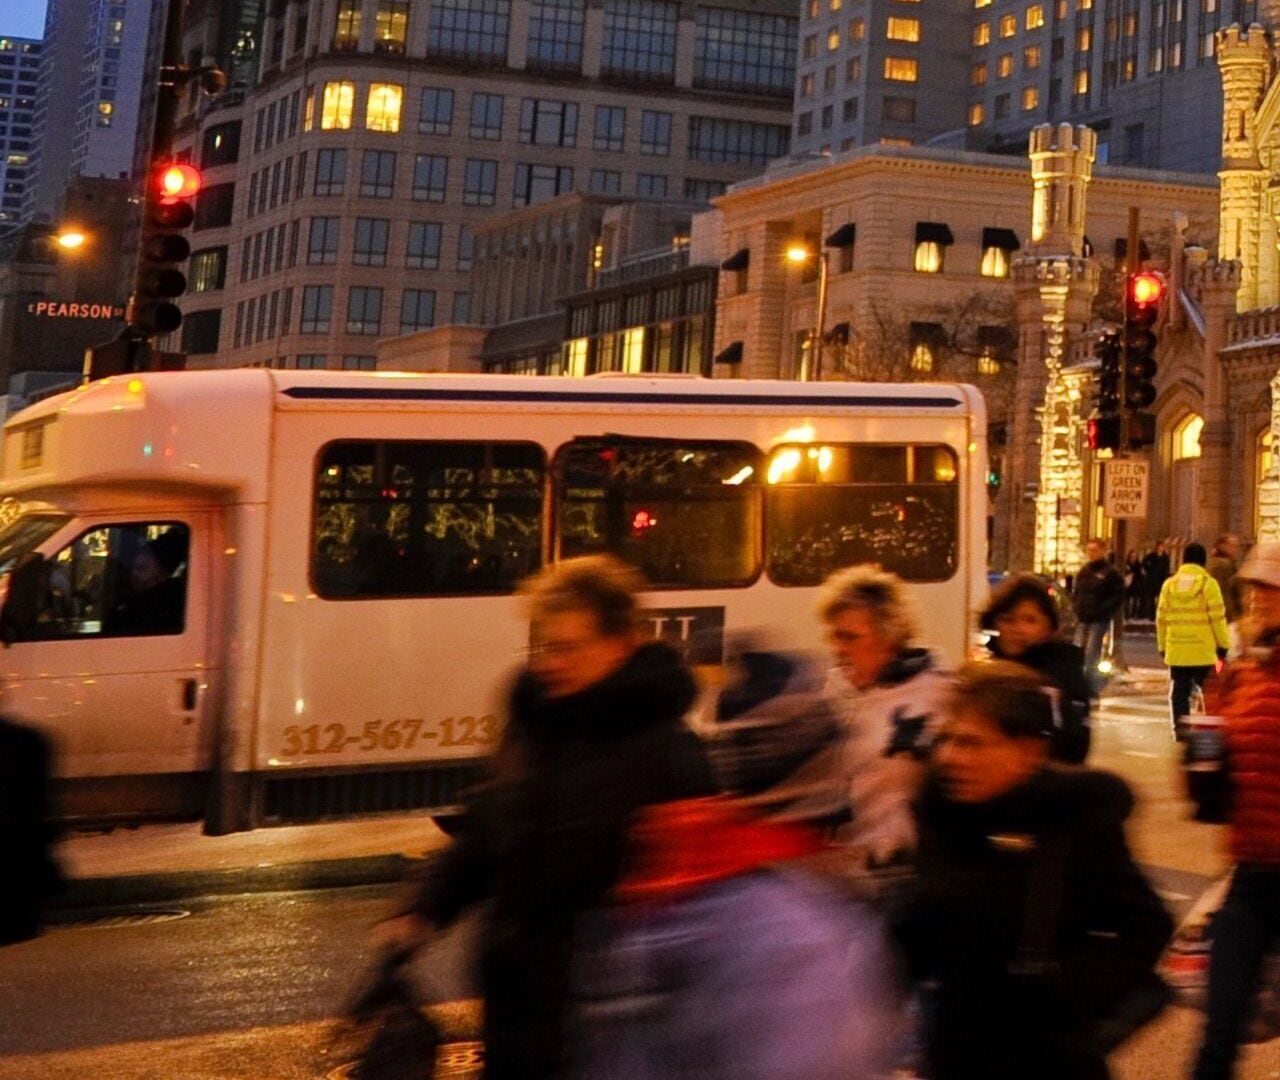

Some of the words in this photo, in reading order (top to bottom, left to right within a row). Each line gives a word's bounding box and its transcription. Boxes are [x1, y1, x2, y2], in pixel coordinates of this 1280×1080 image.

[37, 302, 112, 318] PEARSON
[1109, 463, 1131, 475] LEFT
[1133, 464, 1146, 475] ON
[1112, 476, 1142, 488] GREEN
[1111, 490, 1142, 501] ARROW
[1114, 502, 1137, 514] ONLY
[280, 715, 498, 757] 312-567-123
